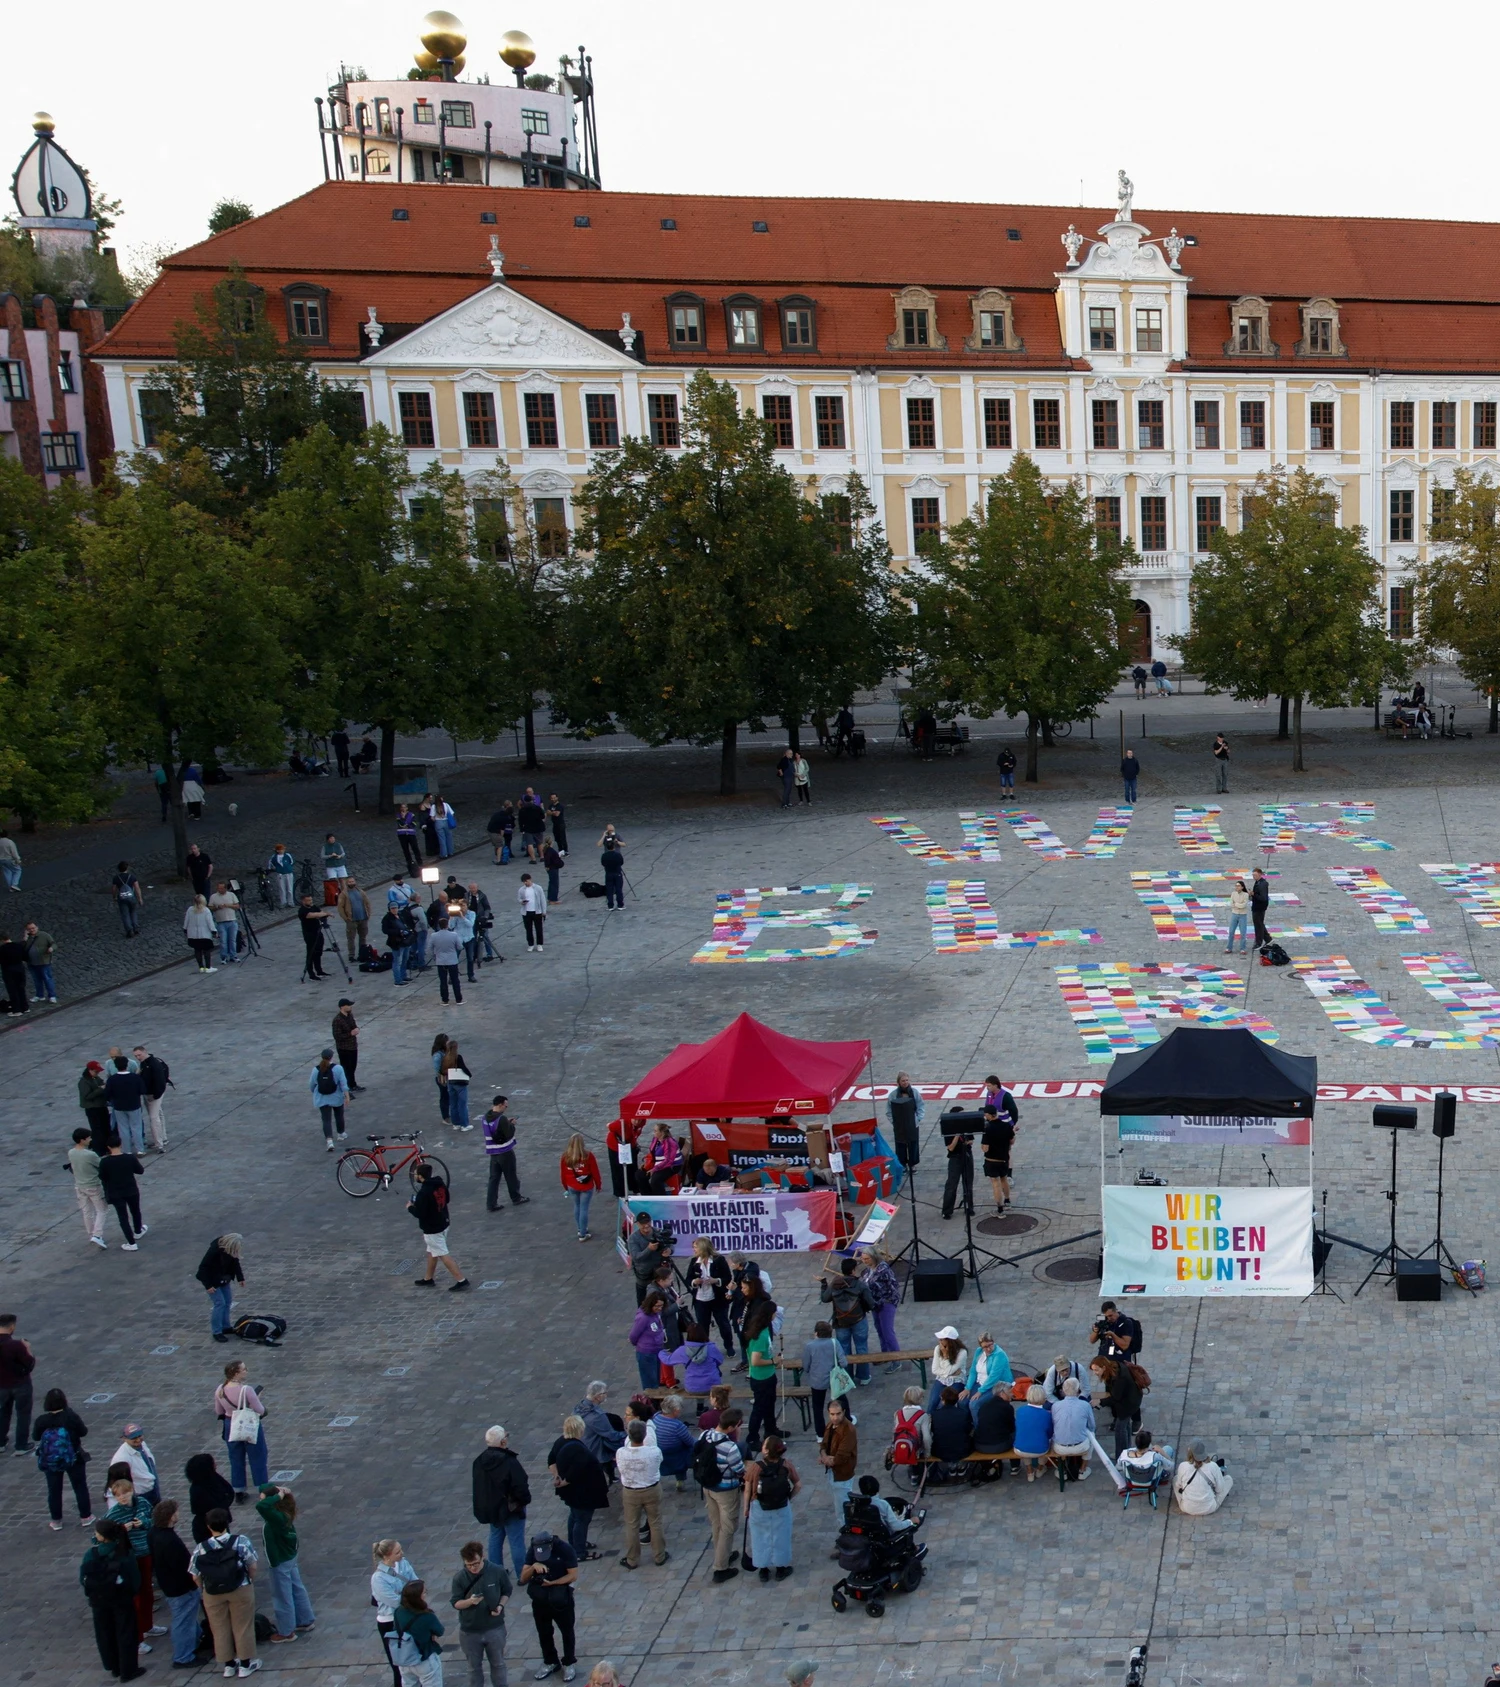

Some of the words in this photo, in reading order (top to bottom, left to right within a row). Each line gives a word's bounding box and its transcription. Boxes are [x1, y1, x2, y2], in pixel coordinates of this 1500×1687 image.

[868, 801, 1396, 866] WIR
[1121, 1134, 1171, 1142] WELTOFFEN
[691, 1199, 769, 1217] VIELFÄLTIG.
[1165, 1193, 1221, 1221] WIR
[706, 1234, 798, 1251] OLIDARISCH.
[1151, 1225, 1266, 1252] BLEIBEN
[1177, 1256, 1261, 1281] BUNT!
